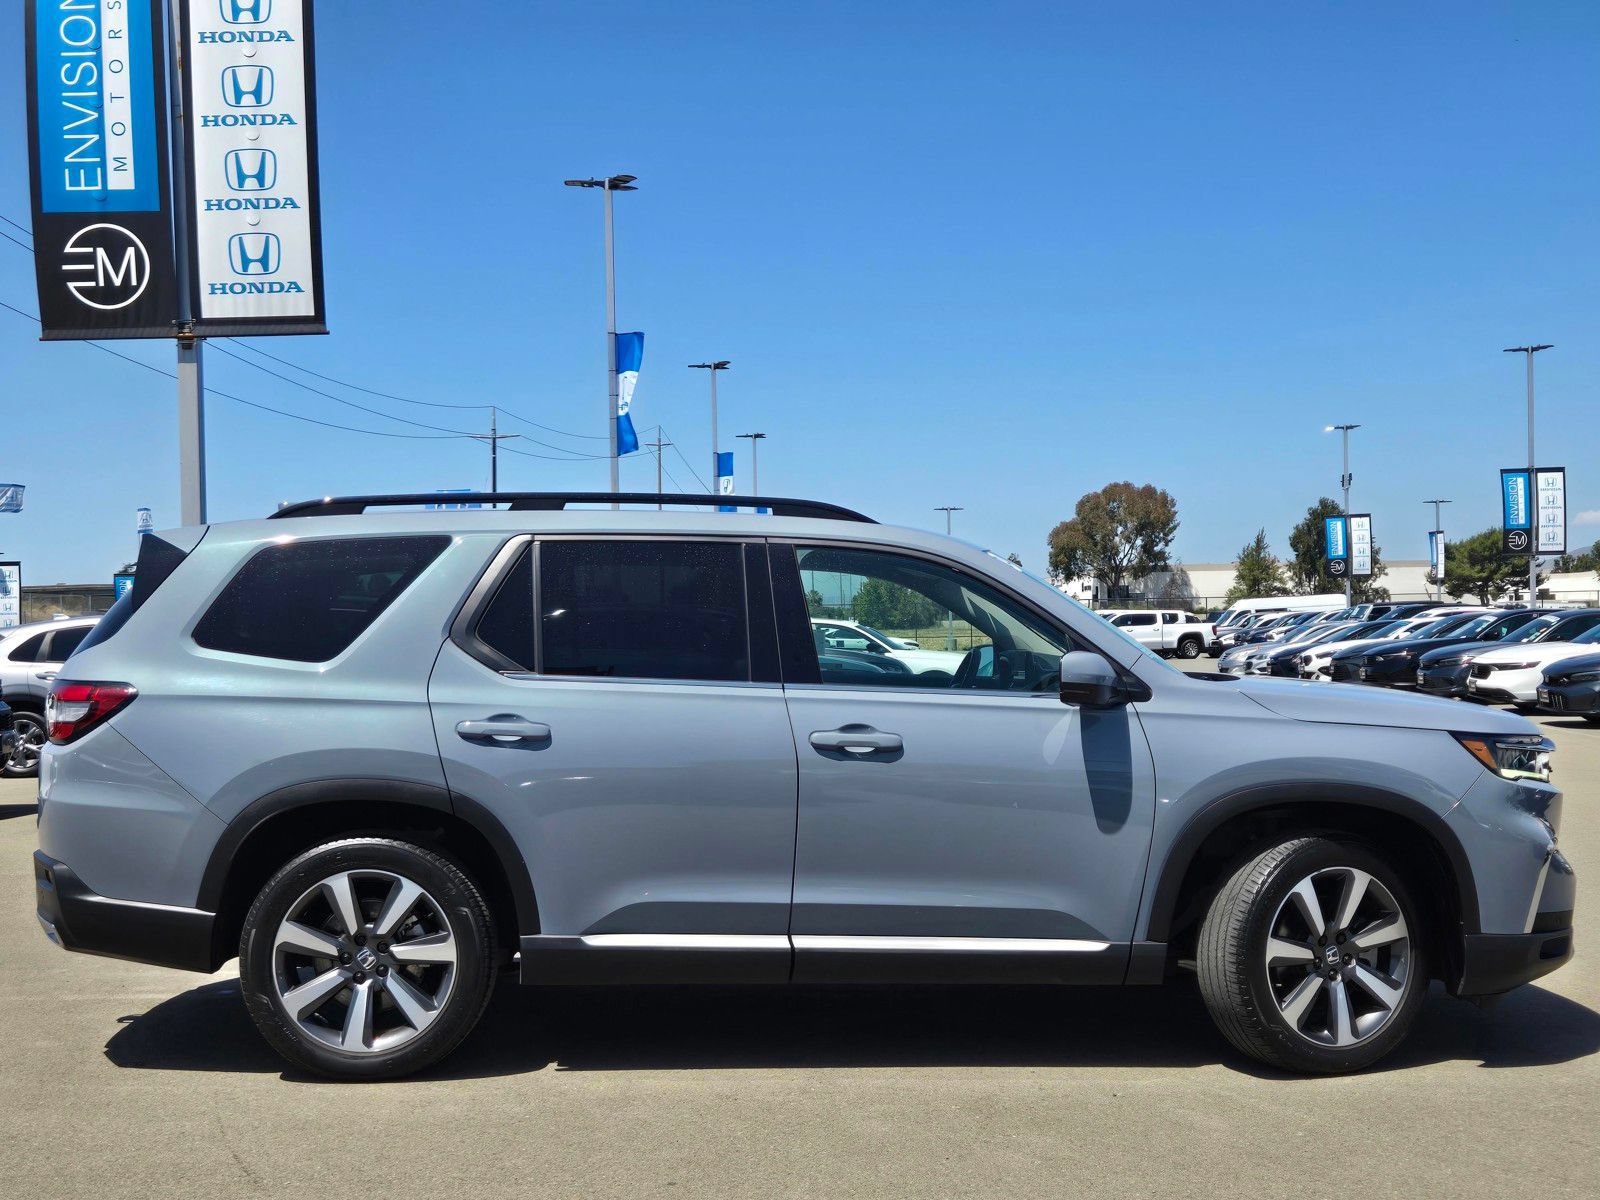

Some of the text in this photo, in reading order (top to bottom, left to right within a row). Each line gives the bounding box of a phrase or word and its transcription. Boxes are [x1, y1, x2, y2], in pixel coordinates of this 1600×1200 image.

[198, 30, 295, 44] HONDA
[107, 1, 128, 172] MOTORS
[201, 113, 298, 128] HONDA
[204, 197, 301, 211] HONDA
[208, 281, 305, 295] HONDA
[1508, 477, 1518, 525] ENVISION
